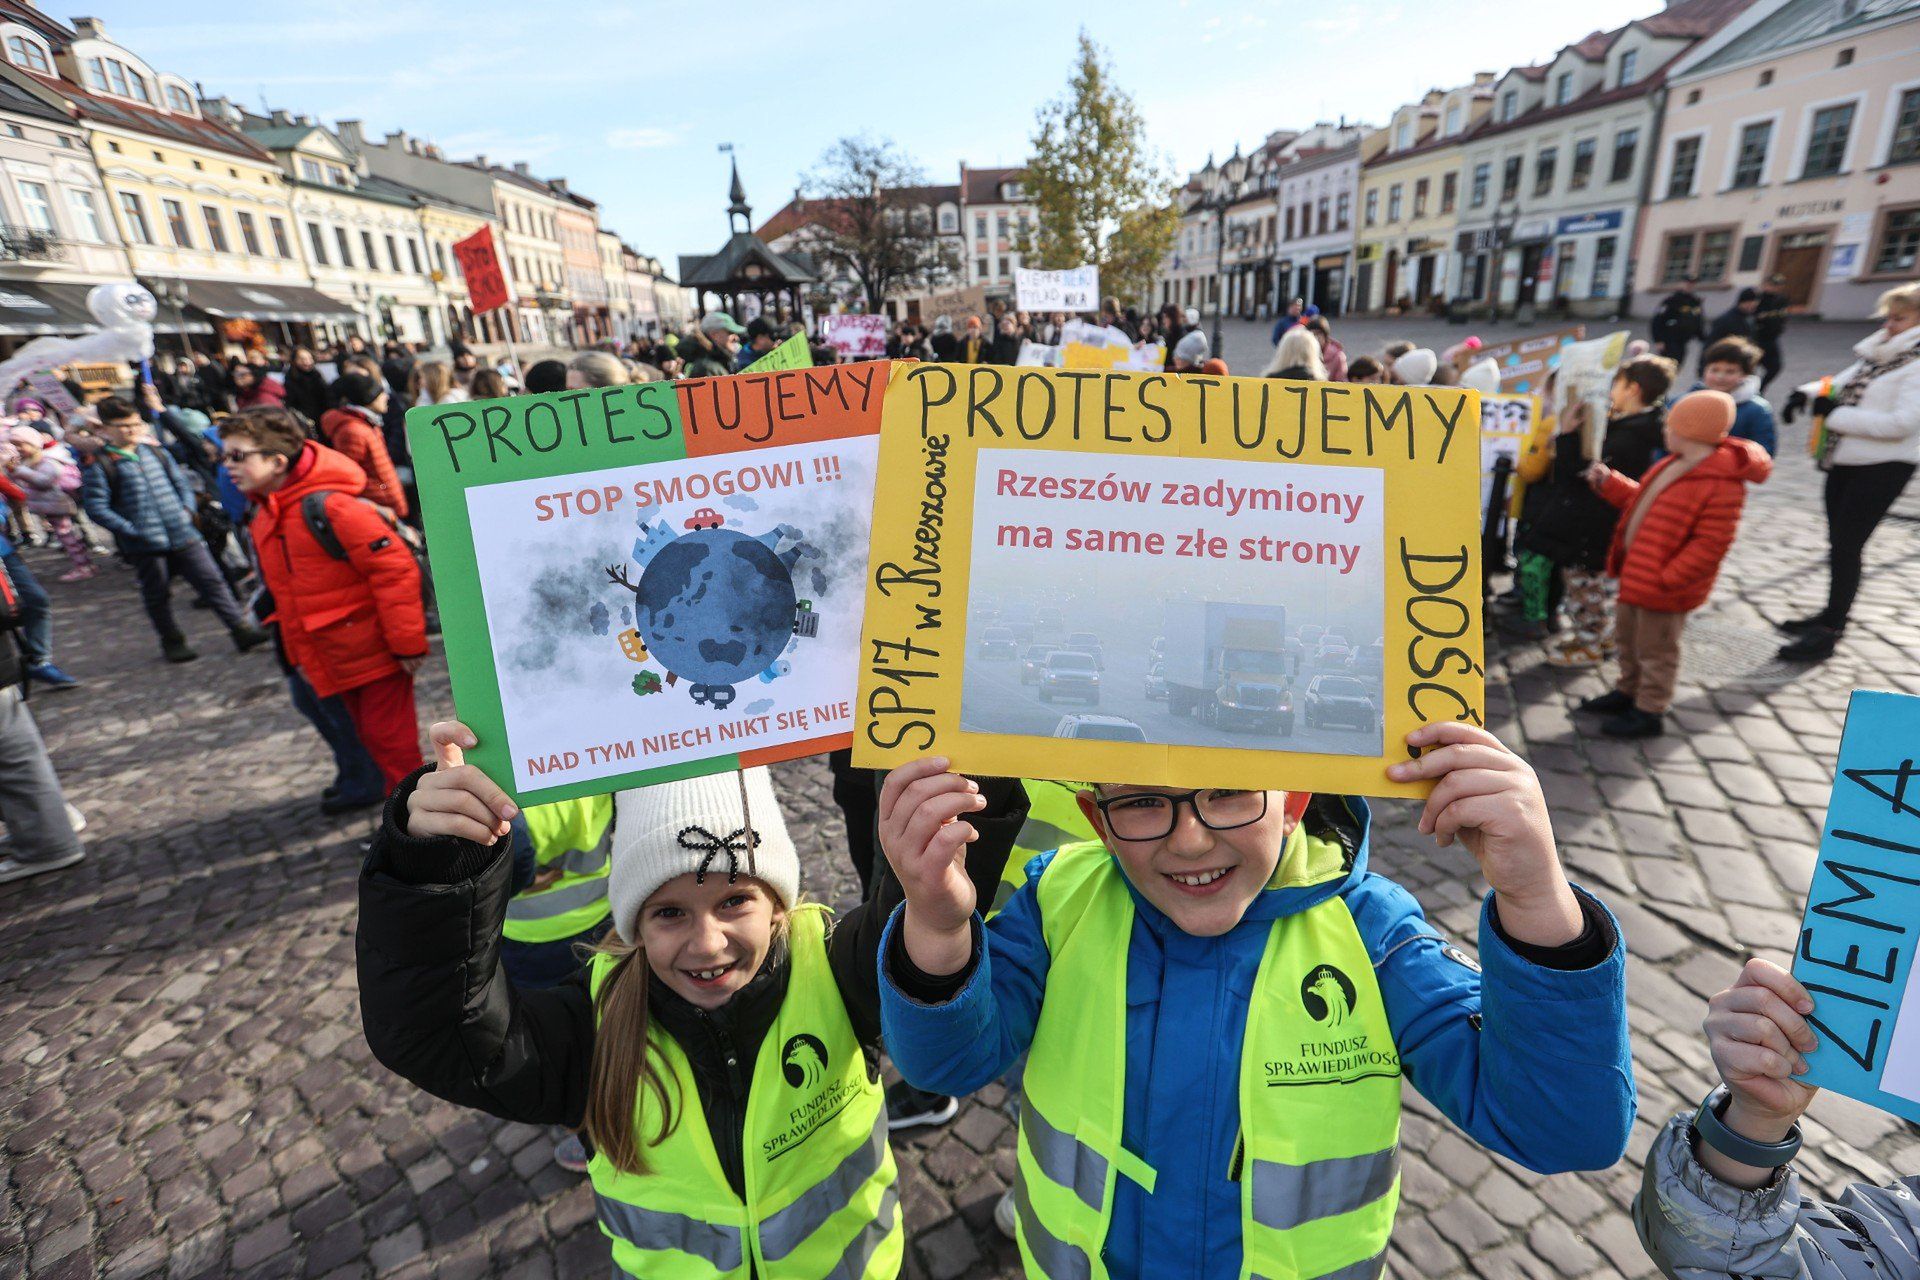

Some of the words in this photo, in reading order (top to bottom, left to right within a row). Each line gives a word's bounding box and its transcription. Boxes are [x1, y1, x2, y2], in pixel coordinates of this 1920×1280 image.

[432, 366, 875, 473] PROTESTUJEMY
[907, 367, 1467, 464] PROTESTUJEMY
[534, 485, 624, 522] STOP
[634, 461, 805, 508] SMOGOWI
[812, 455, 843, 483] !!!
[875, 432, 950, 598] Rzeszowie
[996, 468, 1152, 503] Rzeszów
[1161, 478, 1365, 523] zadymiony
[996, 523, 1053, 549] ma
[1065, 526, 1165, 555] same
[1175, 528, 1228, 558] złe
[1239, 535, 1361, 575] strony
[866, 636, 940, 751] SP17
[527, 751, 580, 777] NAD
[584, 741, 636, 766] TYM
[641, 726, 712, 755] NIECH
[717, 716, 770, 742] NIKT
[775, 708, 809, 731] SIĘ
[813, 701, 851, 724] NIE
[1800, 758, 1920, 1072] ZIEMIA
[1301, 1035, 1368, 1057] FUNDUSZ
[788, 1078, 841, 1124] FUNDUSZ
